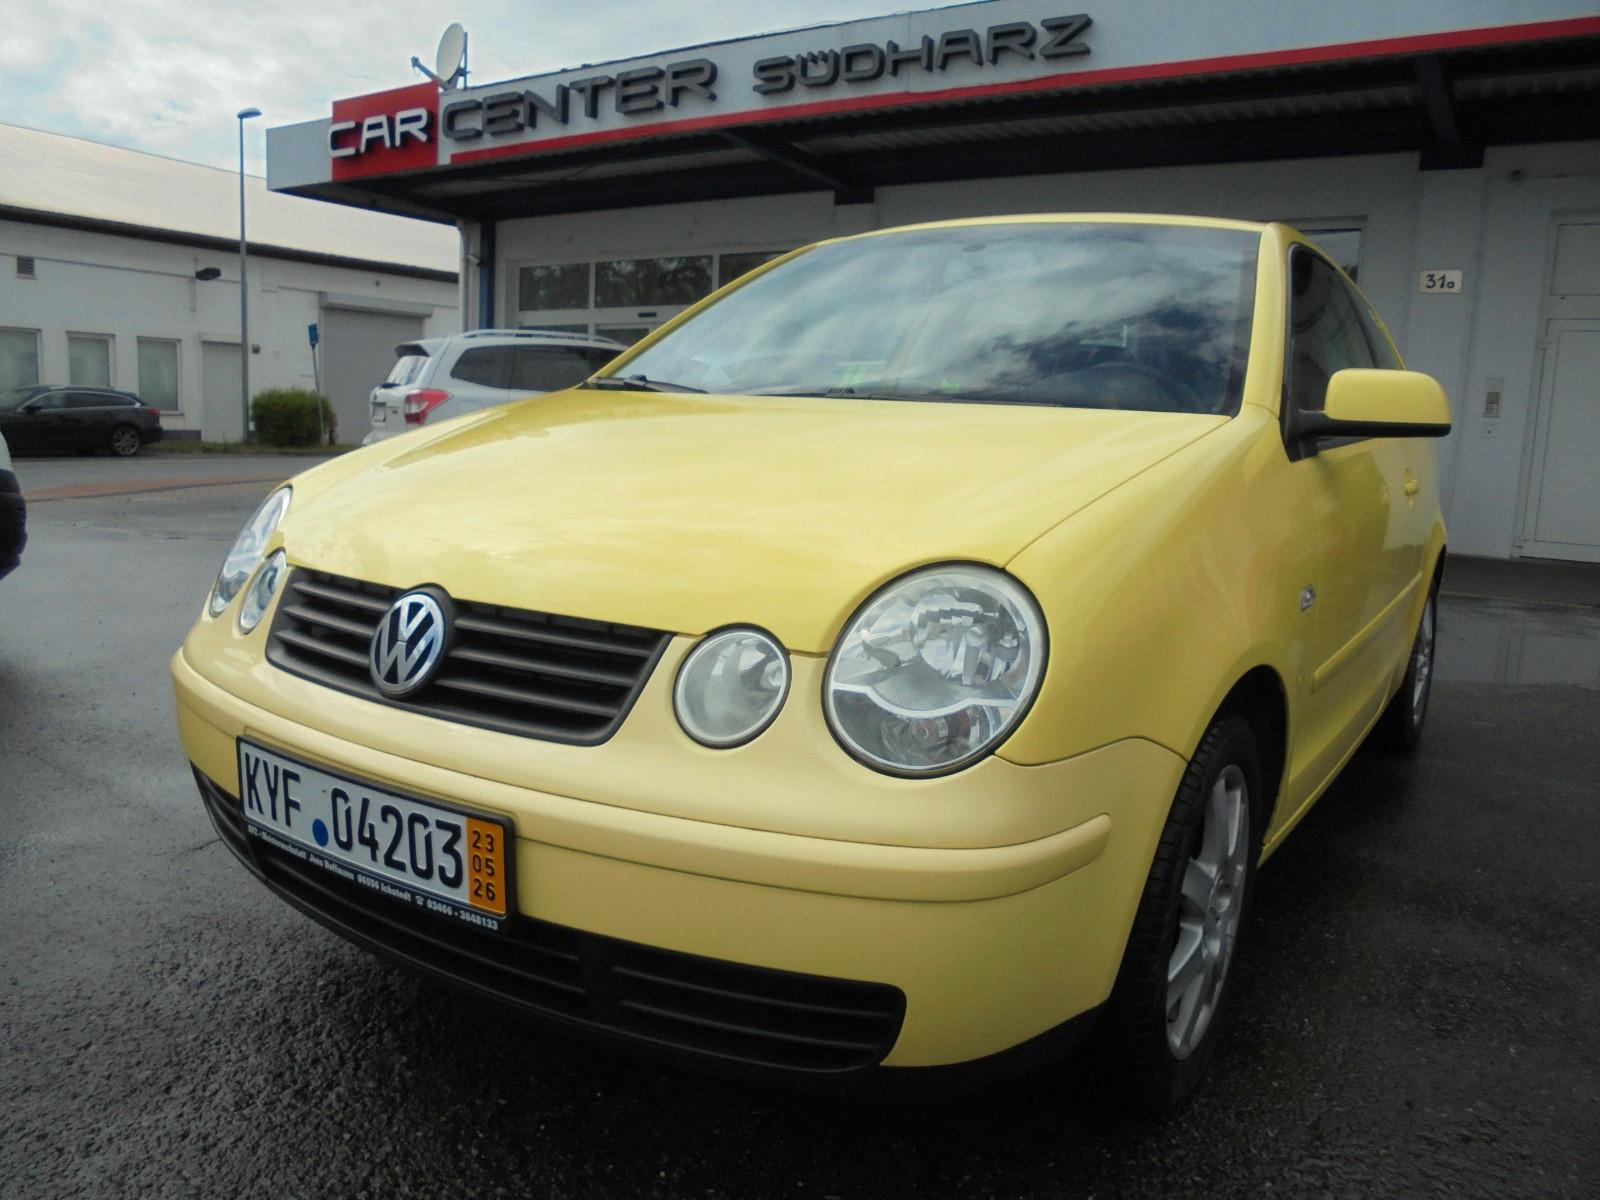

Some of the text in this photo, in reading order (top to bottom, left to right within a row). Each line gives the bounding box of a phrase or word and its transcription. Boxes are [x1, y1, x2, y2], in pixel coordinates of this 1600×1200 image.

[327, 13, 1092, 157] CAR CENTER SÜDHARZ
[1425, 273, 1455, 289] 31a
[245, 751, 301, 828] KYF
[331, 787, 464, 889] 04203
[472, 829, 495, 853] 23
[472, 854, 496, 877] 05
[473, 877, 497, 902] 26
